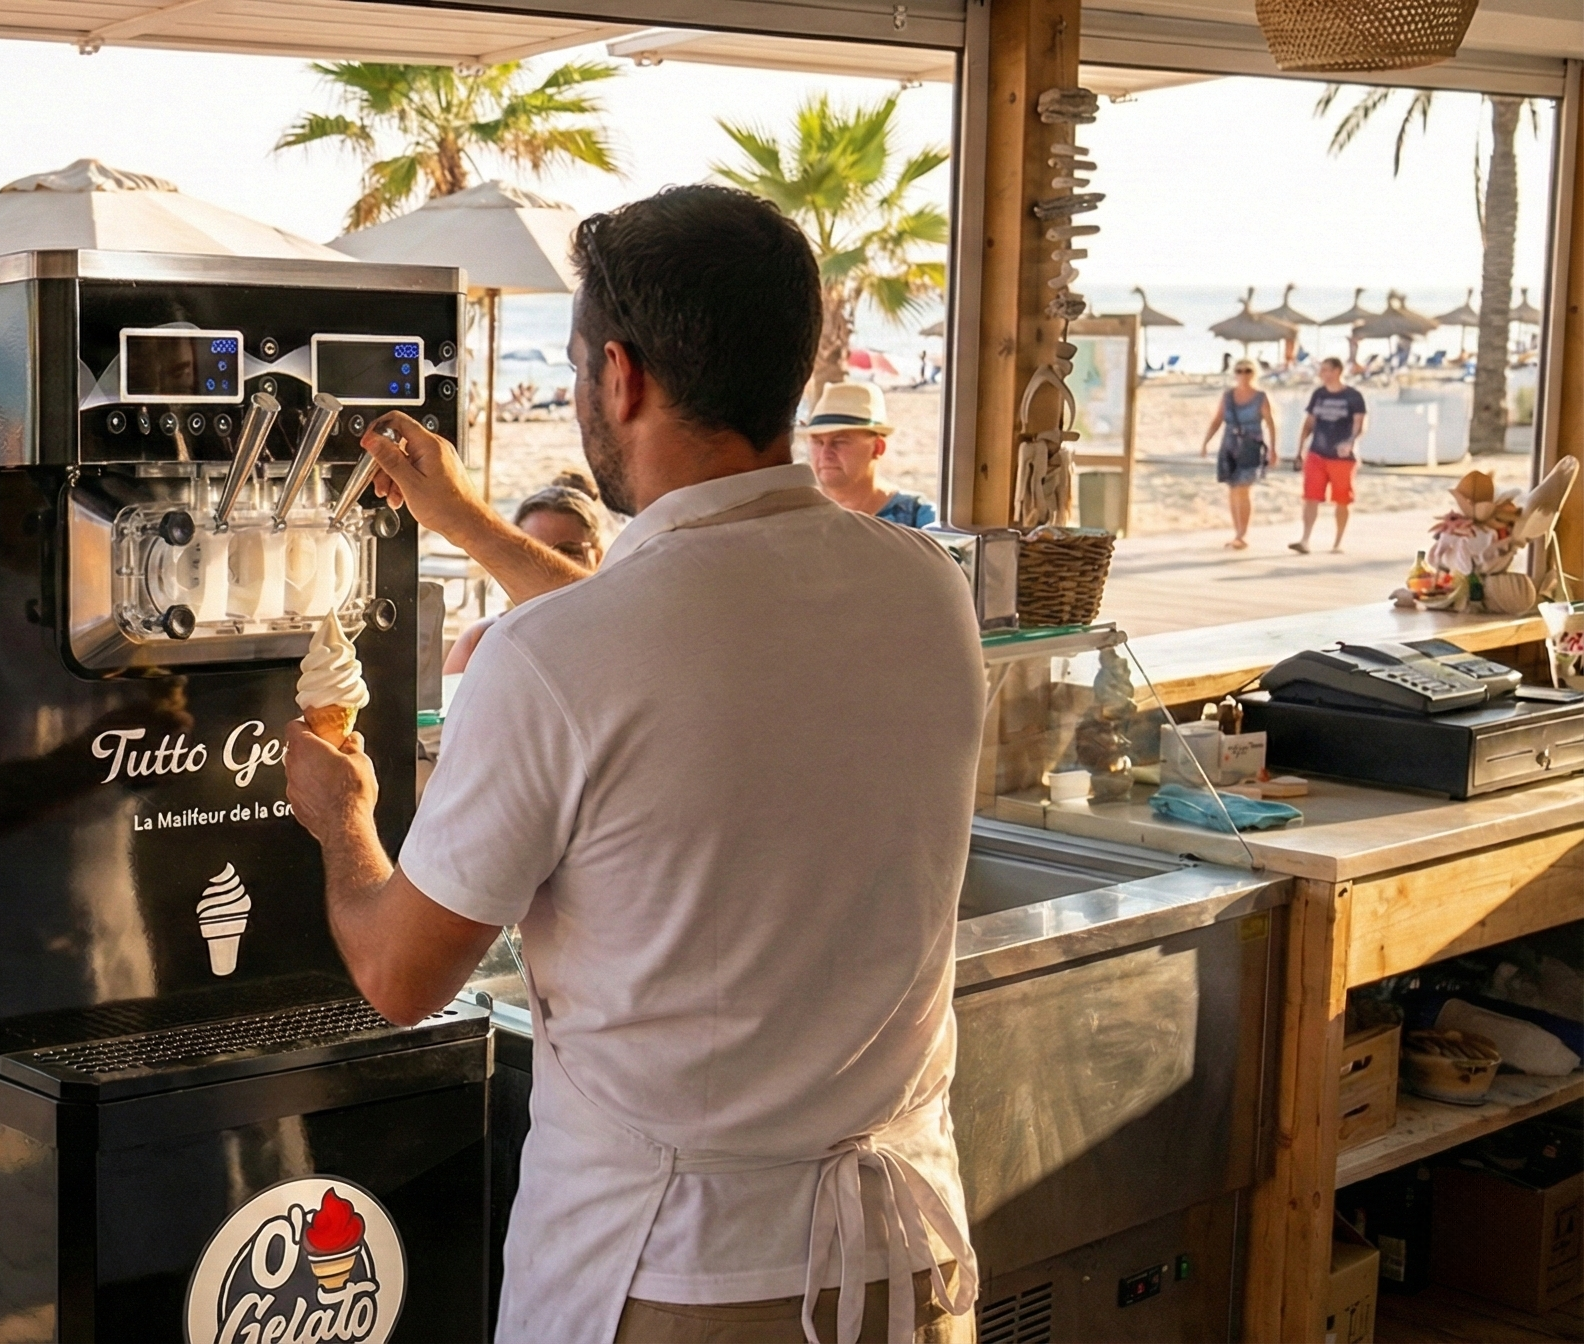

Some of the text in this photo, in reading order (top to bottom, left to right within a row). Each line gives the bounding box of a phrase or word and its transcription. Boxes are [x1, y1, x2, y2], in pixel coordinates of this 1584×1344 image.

[91, 720, 289, 788] Tutto Ge
[134, 815, 153, 831] La
[230, 803, 251, 822] de
[254, 802, 269, 819] la
[272, 800, 296, 818] Gr
[218, 1281, 377, 1344] Gelato
